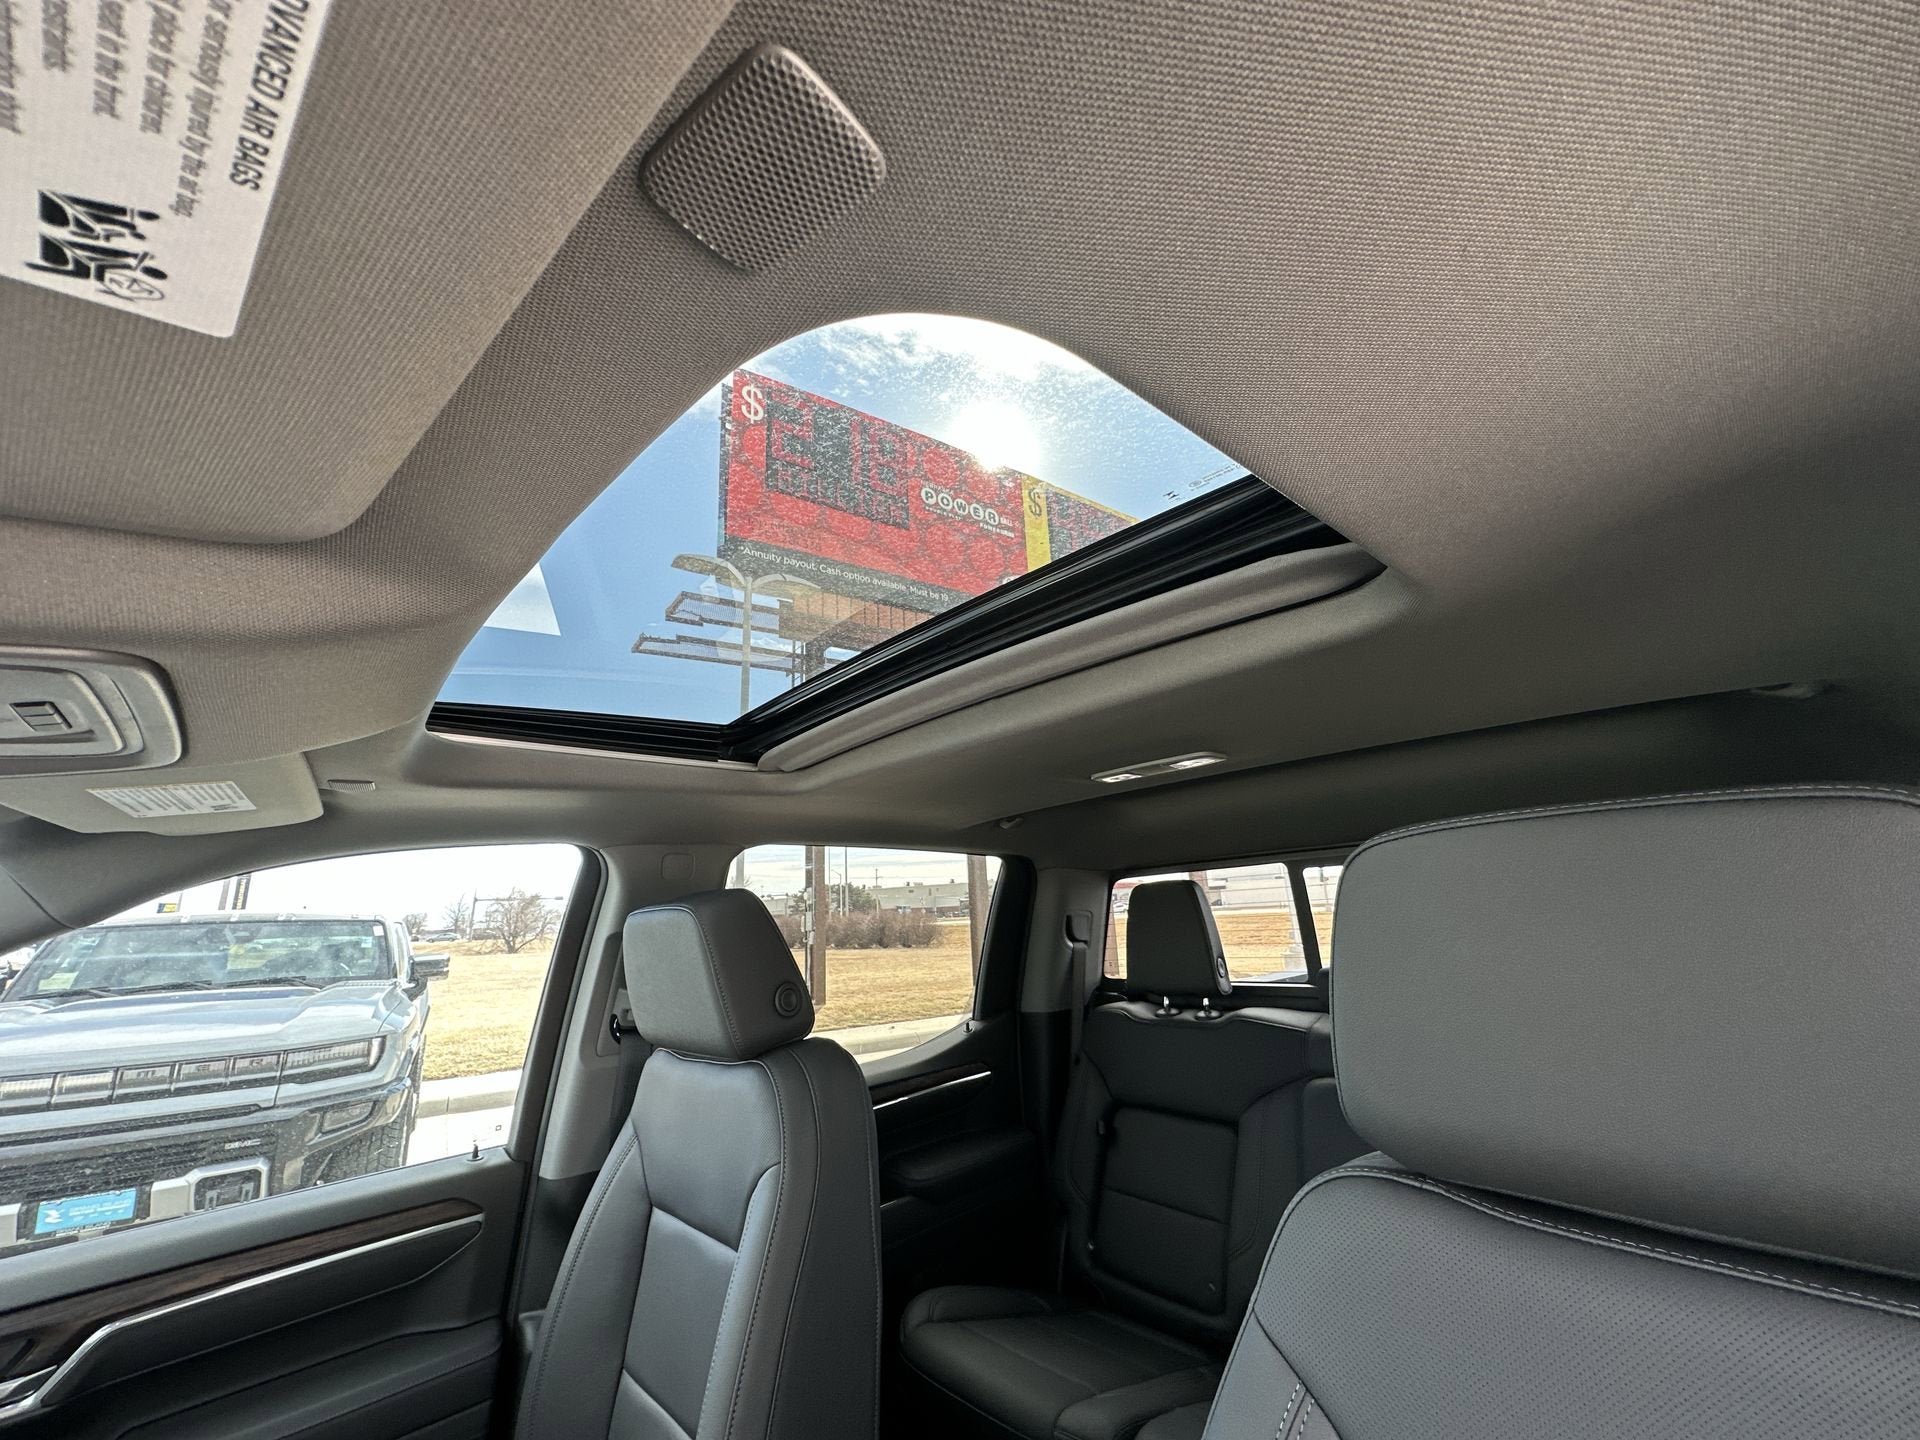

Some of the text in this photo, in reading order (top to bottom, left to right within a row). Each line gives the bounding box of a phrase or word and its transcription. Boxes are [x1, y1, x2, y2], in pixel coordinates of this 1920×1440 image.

[240, 94, 279, 139] AIR
[178, 134, 212, 158] by
[229, 136, 270, 191] BAGS
[181, 153, 208, 178] the
[820, 564, 841, 578] Cash
[843, 571, 871, 584] option
[910, 586, 929, 598] Must
[929, 589, 939, 600] be
